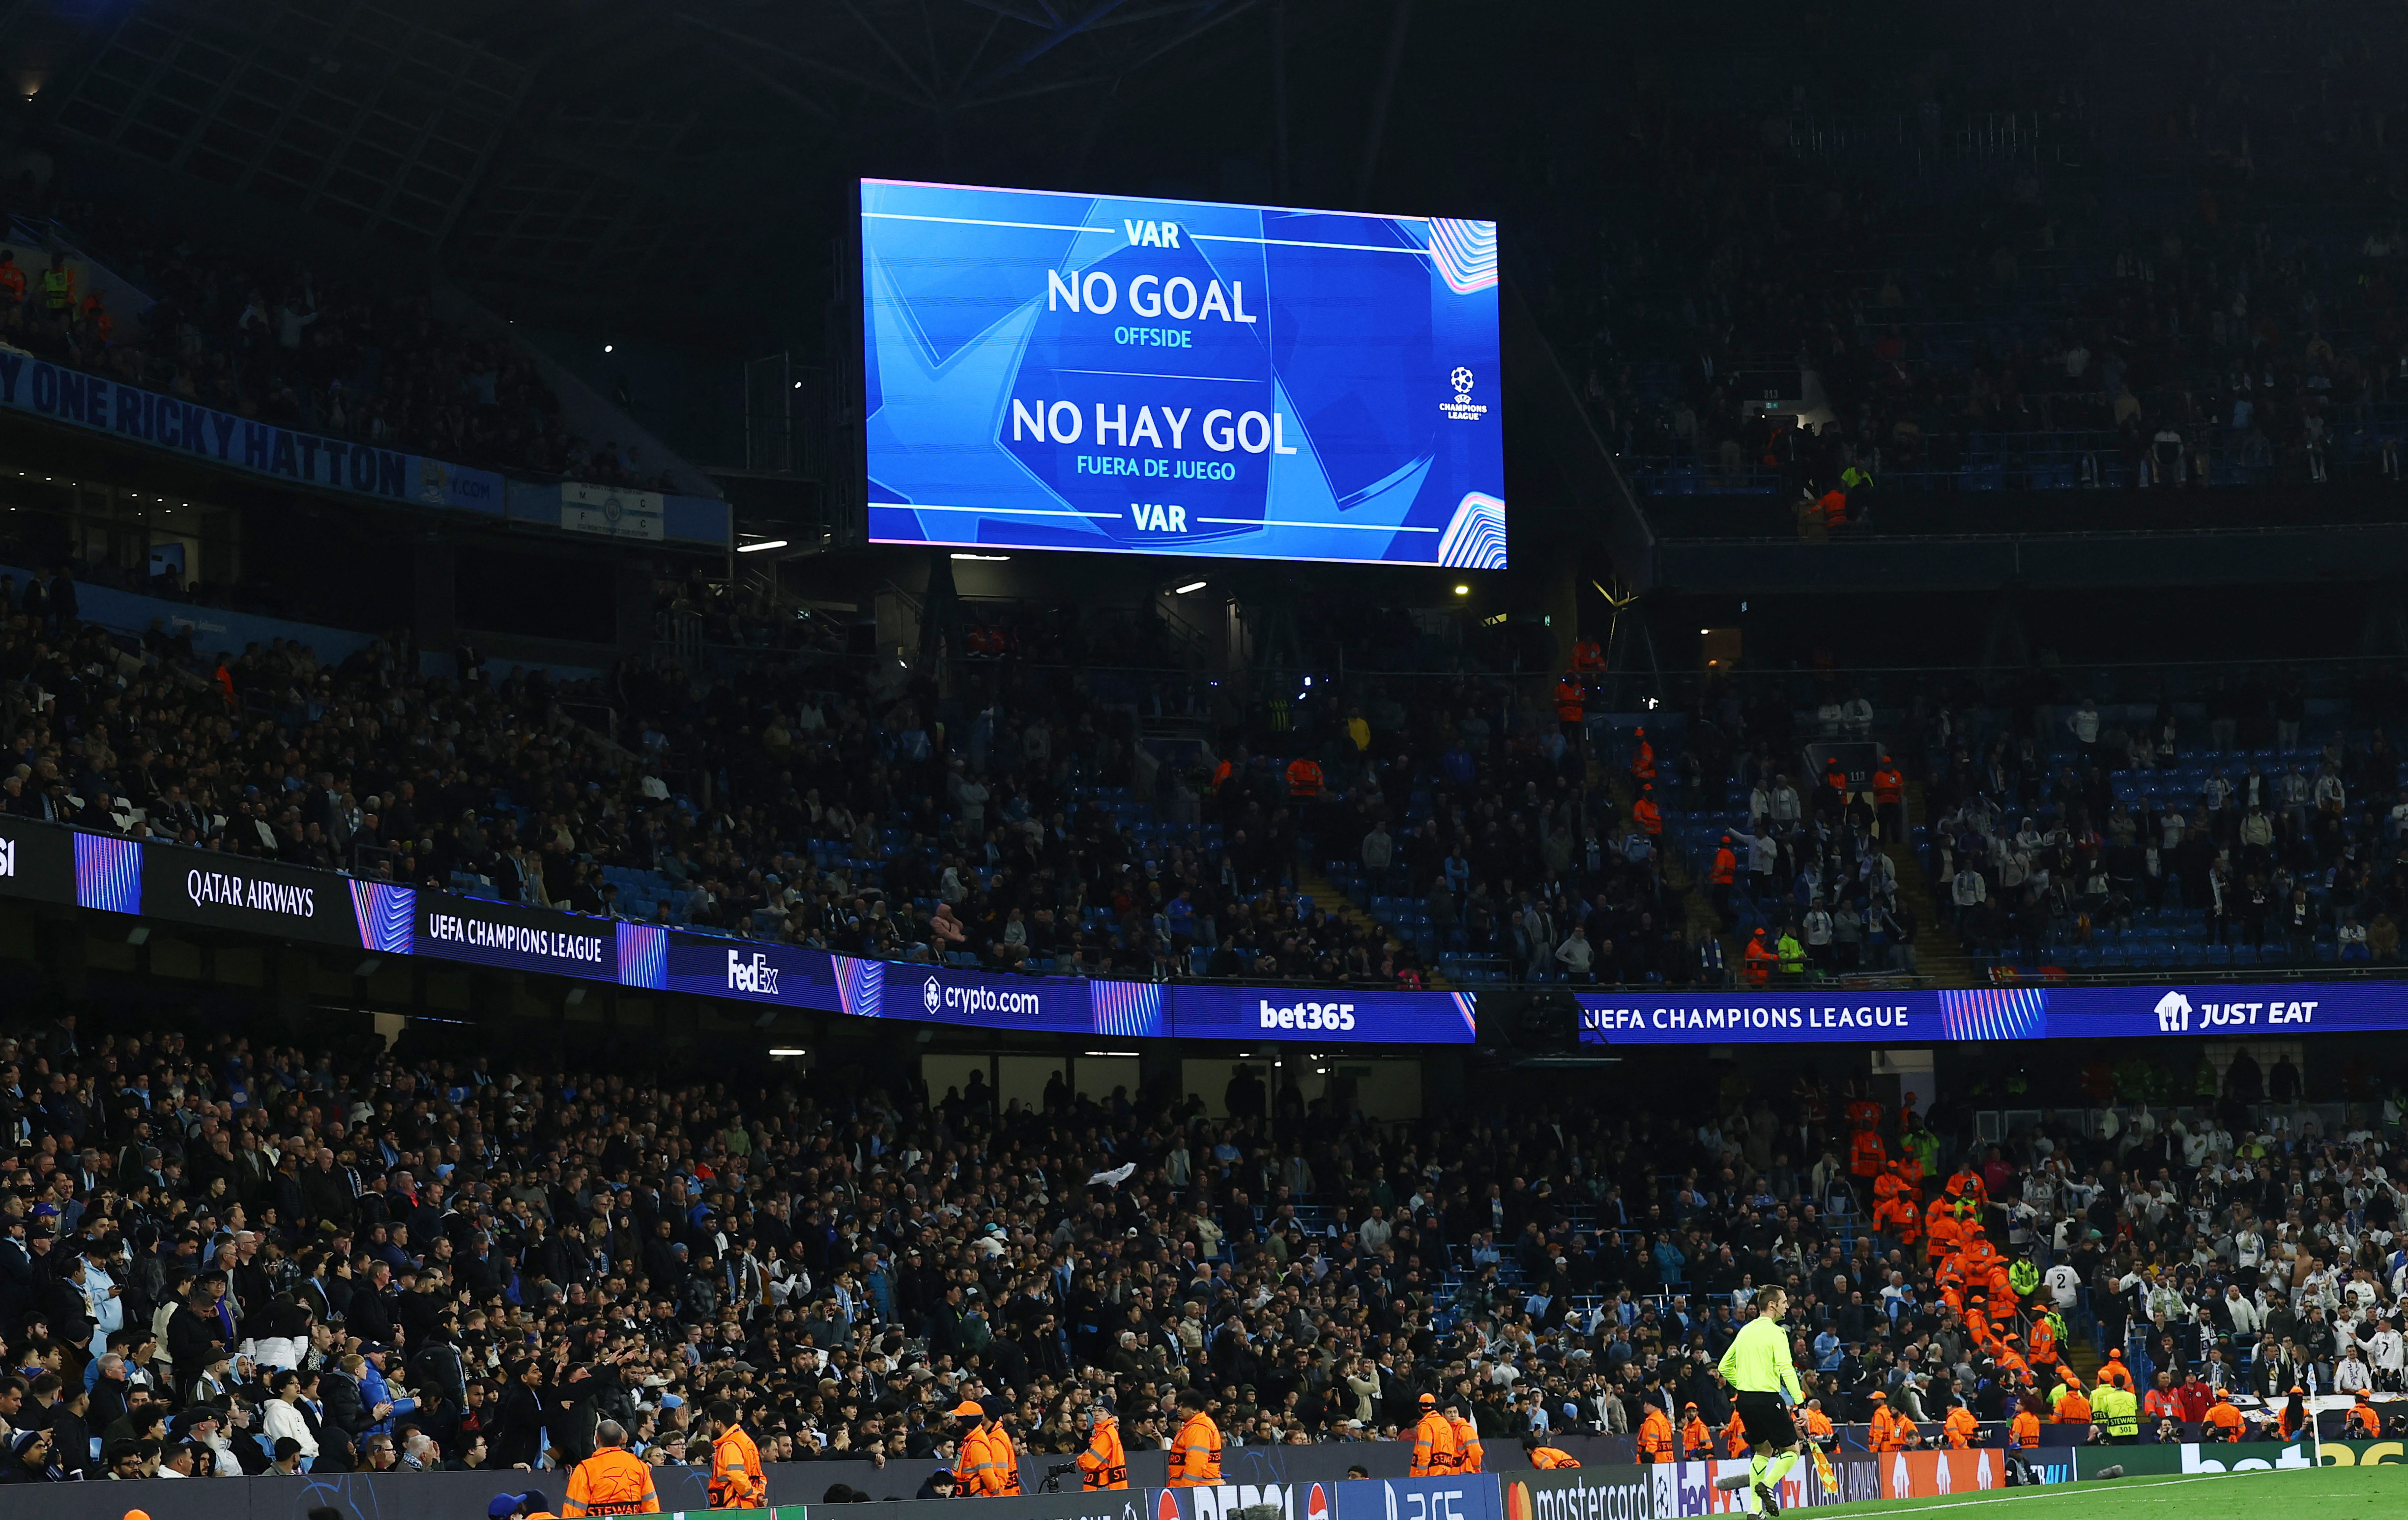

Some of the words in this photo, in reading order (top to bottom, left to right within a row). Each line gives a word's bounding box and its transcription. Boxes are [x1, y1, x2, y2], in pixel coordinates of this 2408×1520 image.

[1124, 219, 1180, 249] VAR
[1048, 269, 1117, 315] NO
[1129, 274, 1257, 323] GOAL
[1114, 326, 1192, 348] OFFSIDE
[1439, 403, 1487, 413] CHAMPIONS
[1448, 412, 1480, 420] LEAGUE
[32, 363, 108, 428] ONE
[116, 386, 237, 460] RICKY
[245, 421, 406, 498] HATTON
[1013, 399, 1082, 444] NO
[1096, 403, 1192, 450] HAY
[1203, 409, 1298, 455] GOL
[1077, 456, 1140, 476] FUERA
[1144, 459, 1169, 477] DE
[1173, 460, 1236, 481] JUEGO
[580, 491, 586, 500] M
[640, 499, 645, 508] C
[640, 519, 645, 528] C
[1131, 503, 1188, 532] VAR
[1850, 771, 1865, 781] 113
[188, 869, 243, 907] QATAR
[246, 879, 314, 918] AIRWAYS
[430, 913, 464, 943] UEFA
[467, 918, 548, 956] CHAMPIONS
[551, 932, 602, 963] LEAGUE
[728, 949, 780, 995] FedEx
[945, 985, 1040, 1015] crypto.com
[1260, 1000, 1356, 1031] bet365
[1584, 1008, 1646, 1029] UEFA
[1652, 1007, 1802, 1029] CHAMPIONS
[1809, 1006, 1909, 1028] LEAGUE
[2199, 1003, 2263, 1030] JUST
[2268, 1001, 2319, 1024] EAT
[2057, 1273, 2065, 1288] 2
[2381, 1341, 2389, 1356] 7
[2110, 1417, 2137, 1425] STEWARD
[1536, 1472, 1650, 1520] mastercard
[1848, 1461, 1879, 1502] AIRWAYS
